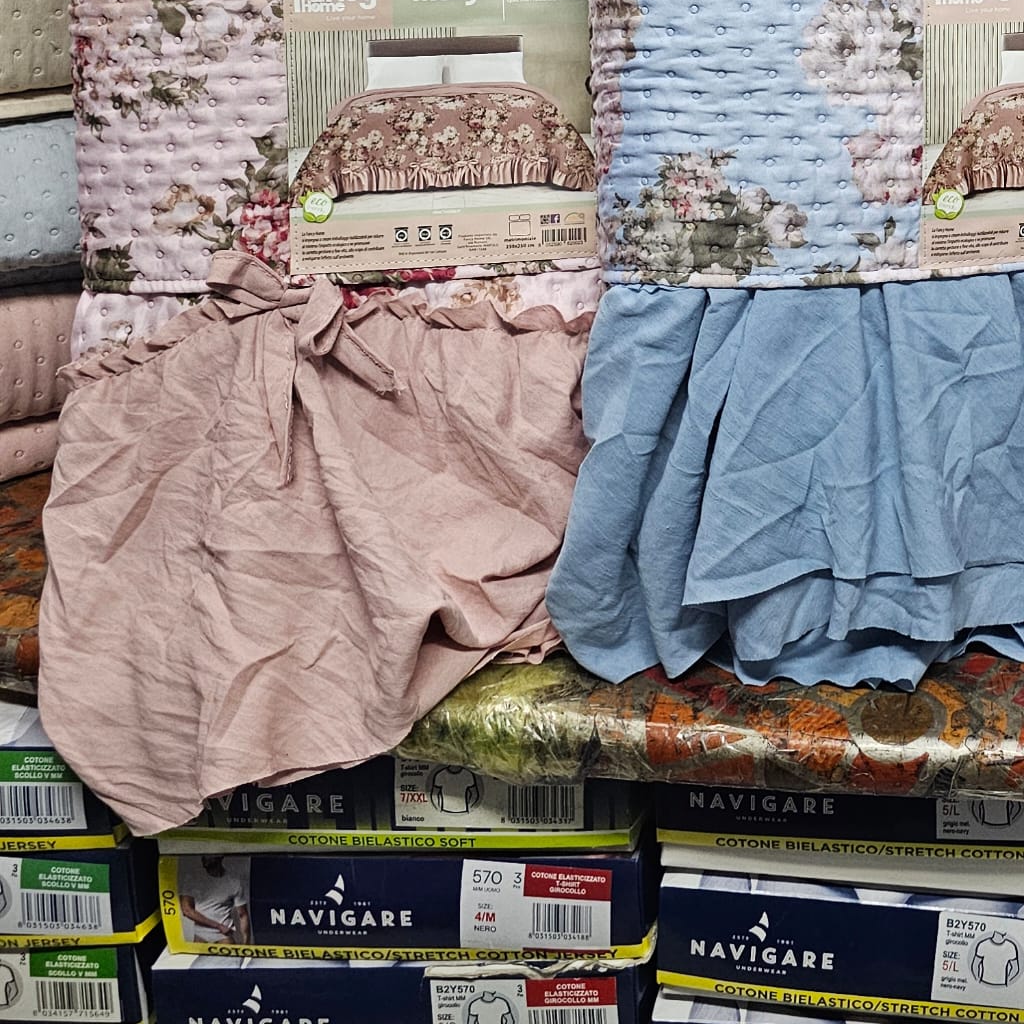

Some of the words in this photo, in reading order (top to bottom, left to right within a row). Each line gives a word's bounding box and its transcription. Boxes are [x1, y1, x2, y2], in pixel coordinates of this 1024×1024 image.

[302, 1, 345, 13] Home
[205, 794, 344, 814] VIGARE
[400, 793, 428, 803] 7/XXL
[689, 791, 835, 815] NAVIGARE
[942, 805, 960, 815] 5/L
[736, 815, 787, 823] UNDERWEAR
[0, 841, 56, 850] JERSEY
[288, 835, 347, 846] COTONE
[353, 836, 435, 847] BIELASTICO
[439, 837, 477, 848] SOFT
[715, 837, 780, 850] COTONE
[785, 841, 956, 857] BIELASTICO/STRETCH
[51, 866, 80, 874] COTONE
[39, 874, 93, 883] ELASTICIZZATO
[473, 870, 502, 884] 570
[514, 872, 522, 883] 3
[531, 871, 558, 879] COTONE
[558, 874, 606, 883] ELASTICIZZATO
[549, 886, 586, 895] GIROCOLLO
[162, 890, 175, 916] 570
[270, 908, 413, 927] NAVIGARE
[474, 912, 496, 922] 4/M
[946, 919, 987, 932] B2Y570
[23, 938, 81, 947] JERSEY
[207, 946, 278, 959] COTONE
[284, 948, 469, 961] BIELASTICO/STRETCH
[476, 950, 550, 960] COTTON
[690, 939, 835, 970] NAVIGARE
[943, 951, 961, 960] SIZE:
[45, 961, 99, 969] ELASTICIZZATO
[735, 965, 787, 976] UNDERWEAR
[942, 960, 959, 972] 5/L
[436, 984, 475, 993] B2Y570
[517, 984, 523, 993] 3
[714, 983, 778, 1001] COTONE
[783, 992, 950, 1017] BIELASTICO/STRETCH
[956, 1007, 1020, 1022] COTTON
